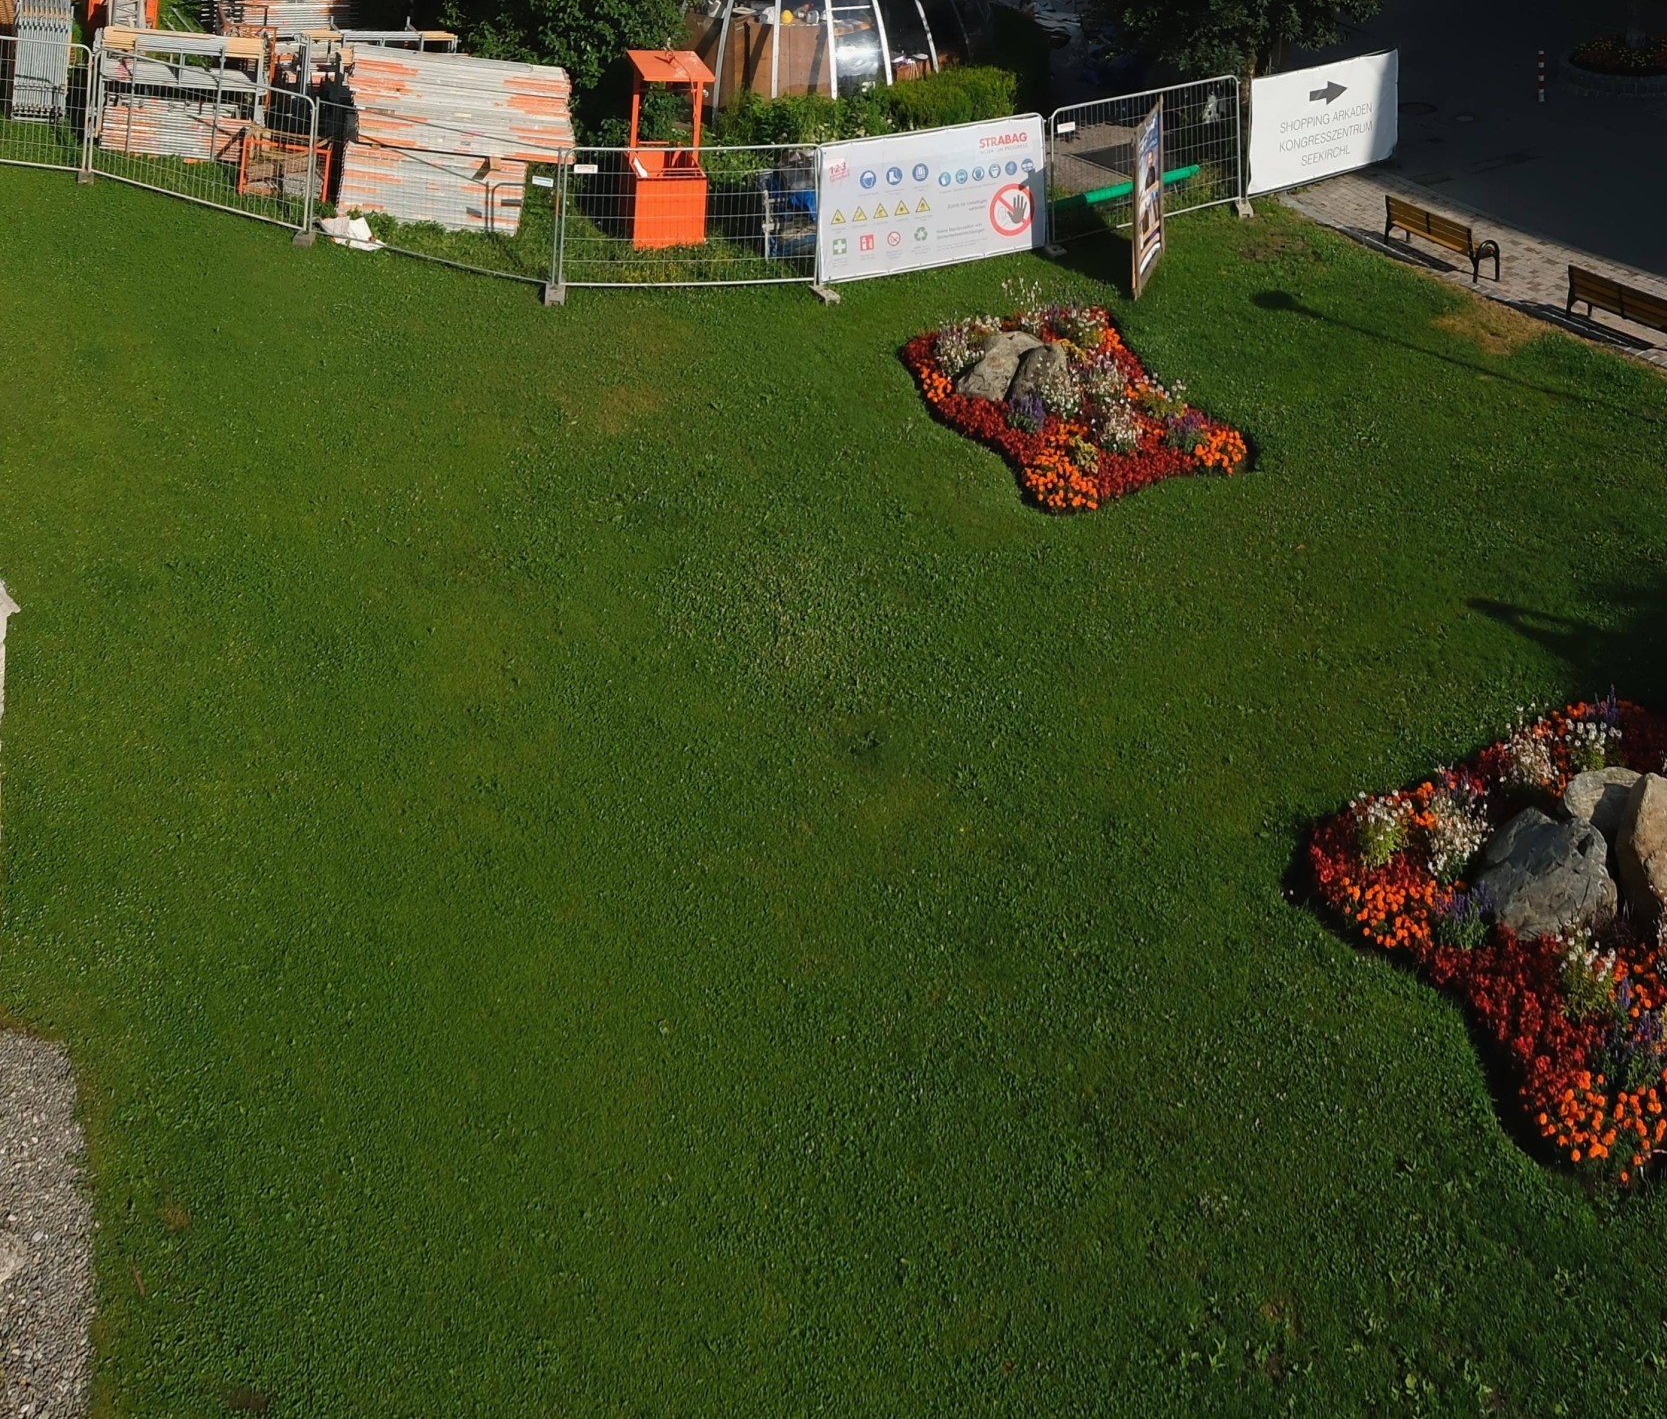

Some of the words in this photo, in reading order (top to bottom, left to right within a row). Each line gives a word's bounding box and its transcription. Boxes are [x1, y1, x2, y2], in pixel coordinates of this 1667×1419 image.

[1280, 113, 1330, 134] SHOPPING
[1332, 102, 1373, 123] ARKADEN
[979, 132, 1028, 149] STRABAG
[1279, 120, 1373, 153] KONGRESSZENTRUM
[1300, 144, 1351, 168] SEEKIRCHL
